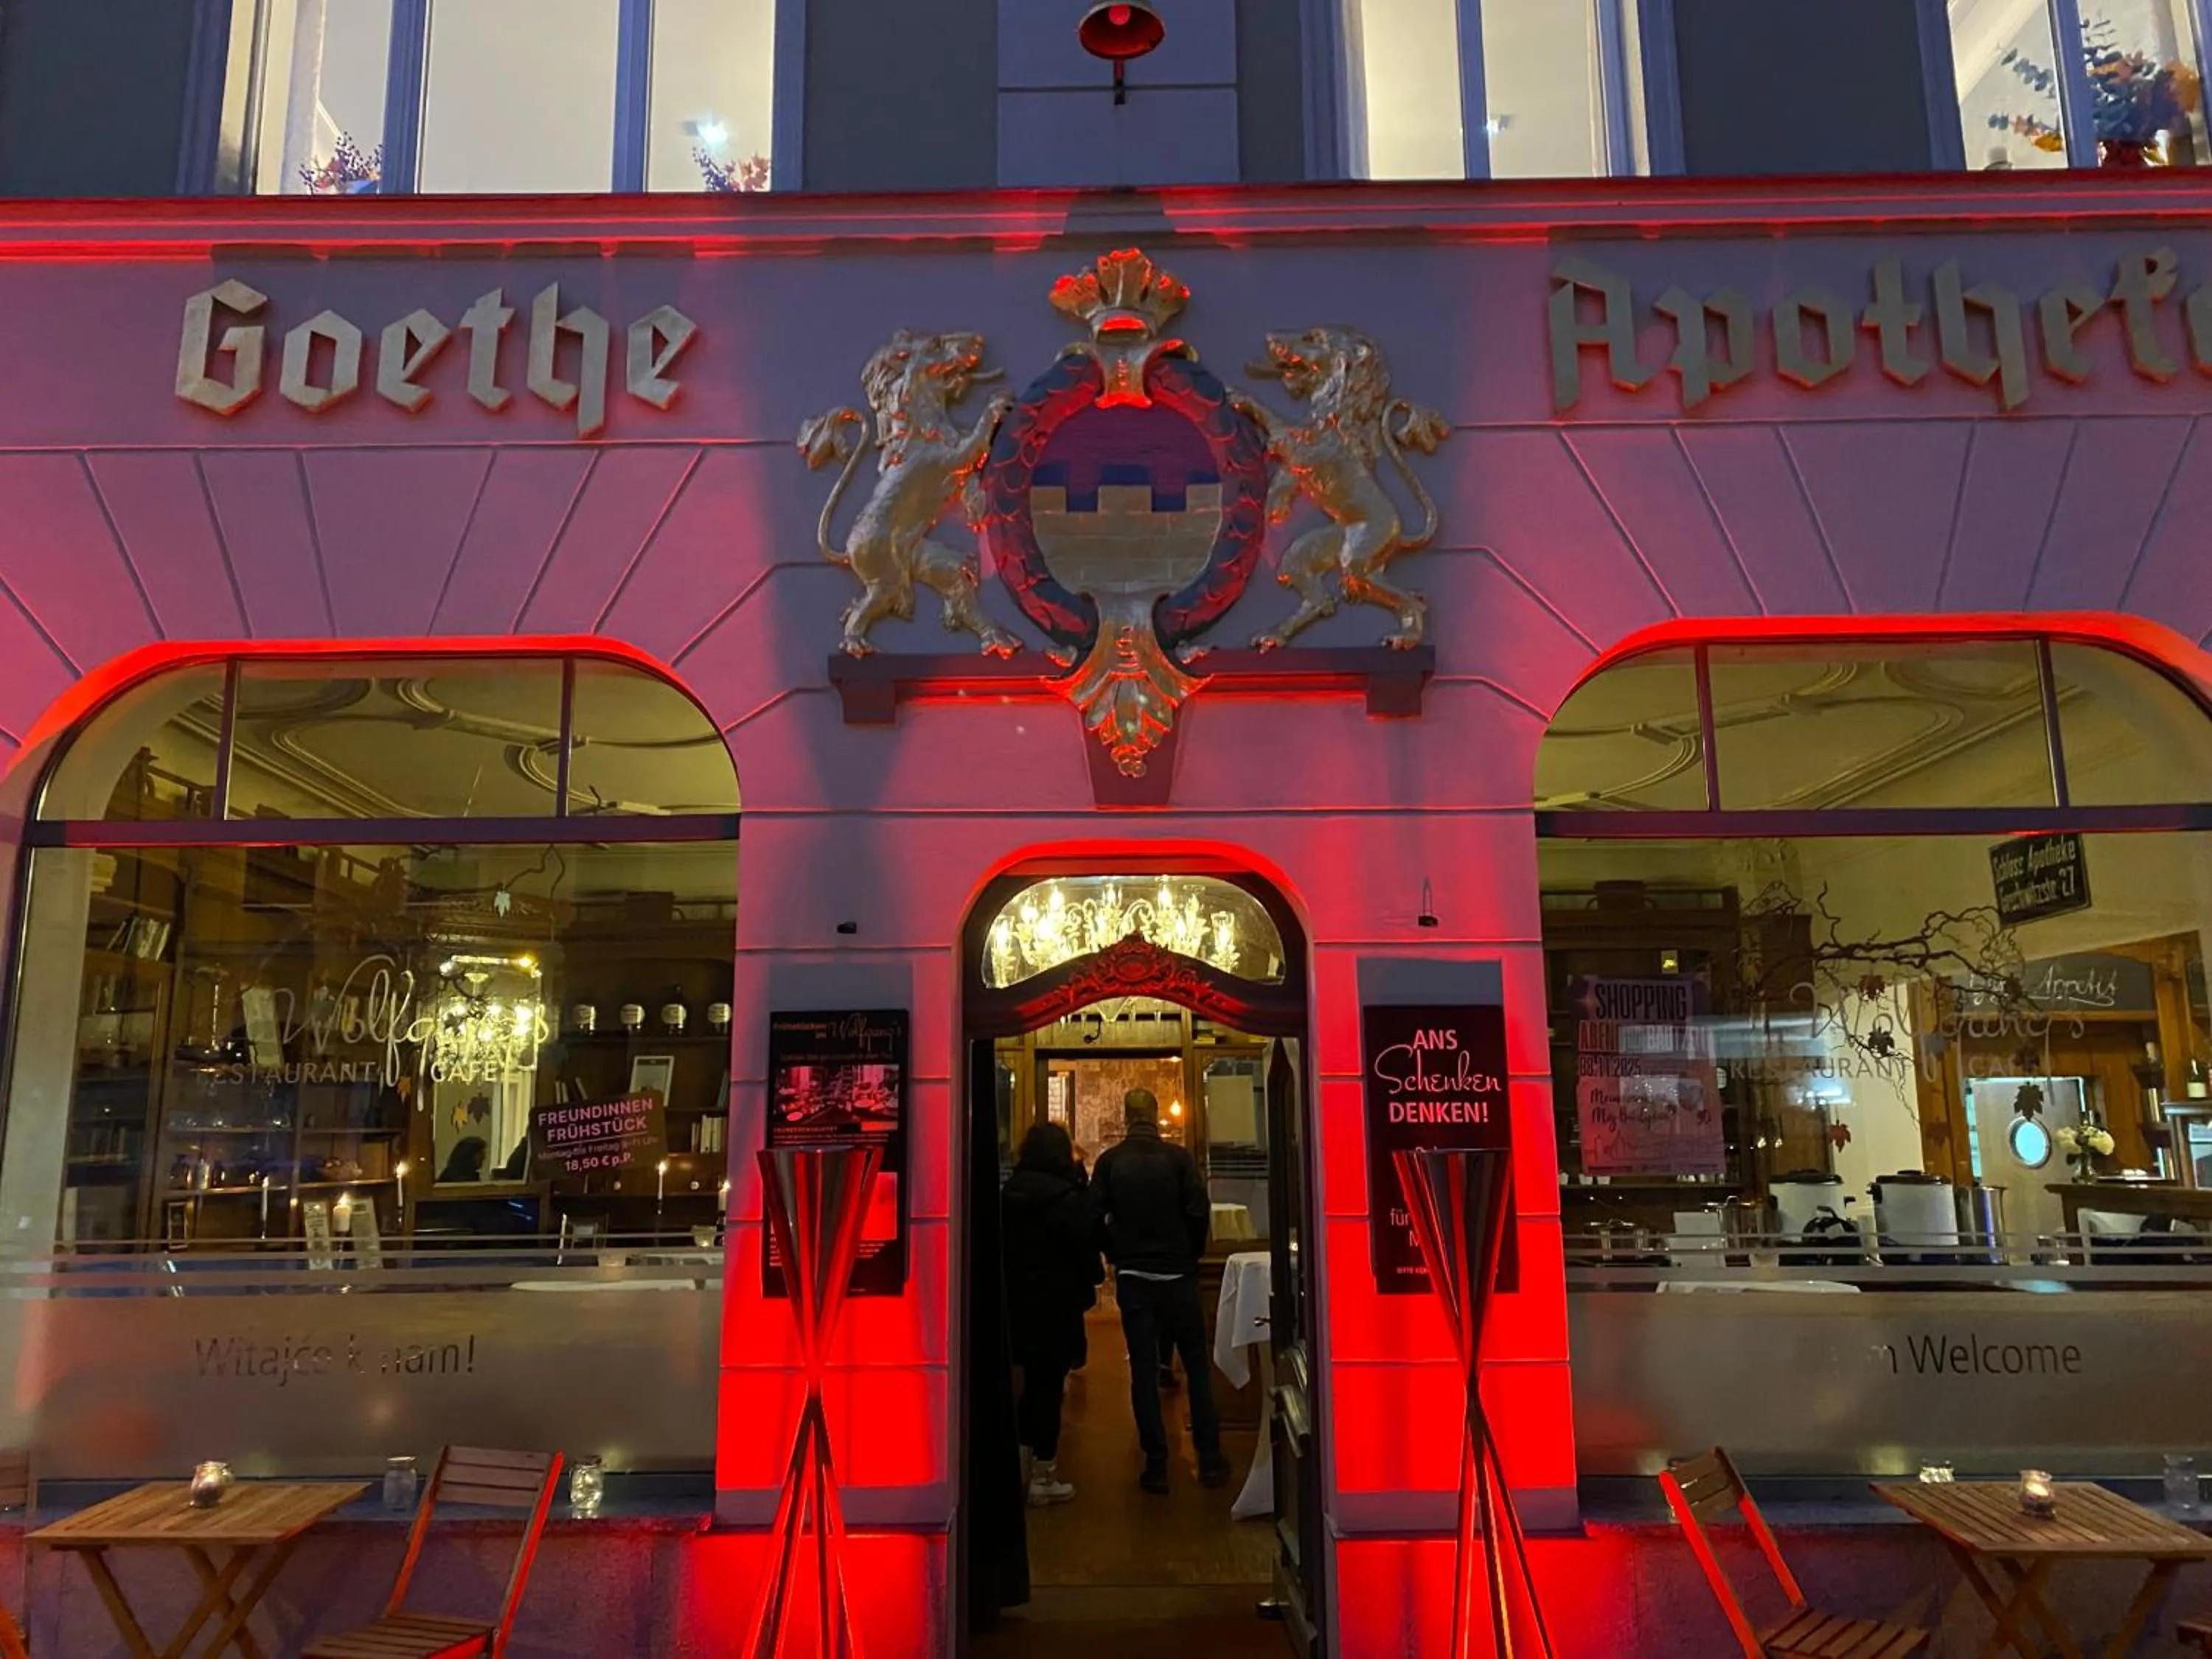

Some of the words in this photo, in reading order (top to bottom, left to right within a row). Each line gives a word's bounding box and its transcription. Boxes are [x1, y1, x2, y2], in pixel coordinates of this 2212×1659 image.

[175, 278, 698, 441] Goethe
[2058, 865, 2075, 897] 27
[1594, 983, 1688, 1020] SHOPPING
[1413, 1029, 1458, 1050] ANS
[1374, 1043, 1502, 1095] Schenken
[538, 1098, 653, 1127] FREUNDINNEN
[1389, 1102, 1489, 1123] DENKEN!
[547, 1116, 647, 1143] FRÜHSTÜCK
[565, 1157, 599, 1172] 18,50
[1907, 1332, 2082, 1374] Welcome
